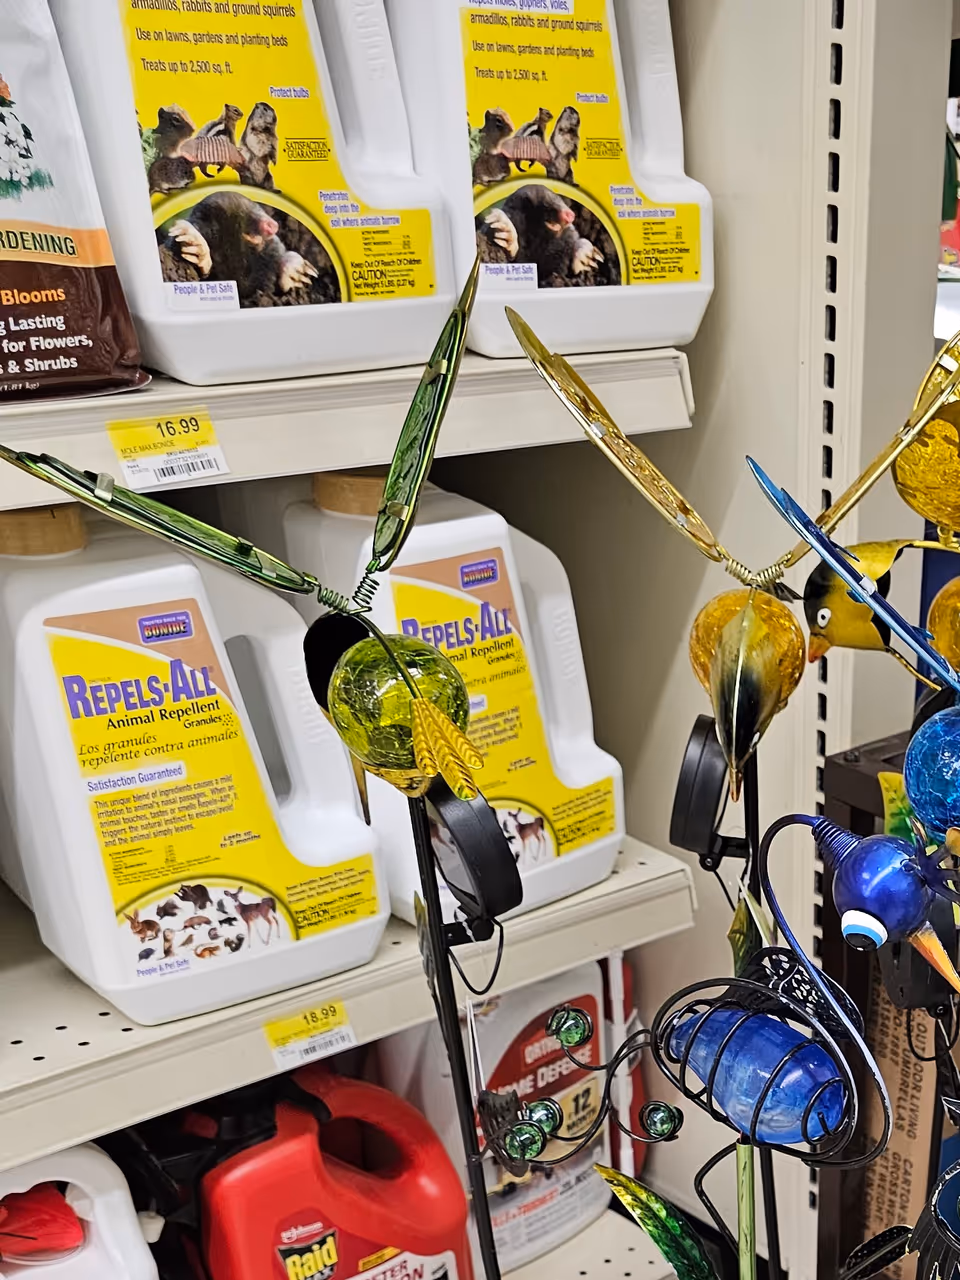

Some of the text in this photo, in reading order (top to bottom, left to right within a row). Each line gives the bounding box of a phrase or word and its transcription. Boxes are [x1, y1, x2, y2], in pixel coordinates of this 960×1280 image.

[182, 0, 212, 13] rabbits
[215, 0, 230, 14] and
[232, 2, 260, 17] ground
[262, 3, 295, 19] squirrels
[136, 27, 288, 48] Use on lawns, gardens and planting beds
[141, 57, 167, 72] Treats
[168, 60, 179, 74] up
[180, 60, 188, 73] to
[190, 60, 211, 75] 2,500
[352, 268, 387, 281] CAUTION
[0, 288, 66, 306] Blooms
[173, 283, 199, 295] People
[206, 283, 219, 294] Pet
[219, 282, 234, 294] Safe
[8, 314, 66, 331] Lasting
[2, 333, 94, 353] for Flowers,
[7, 359, 20, 374] &
[24, 355, 79, 373] Shrubs
[156, 416, 200, 438] 16.99
[143, 621, 188, 639] BONIDE
[470, 637, 515, 659] Repellent
[106, 699, 221, 730] Animal Repellent
[183, 712, 223, 729] Granules
[78, 732, 158, 756] Los granules
[81, 729, 239, 770] repelente contra animales
[87, 765, 183, 793] Satisfaction Guaranteed
[303, 1004, 337, 1026] 18.99
[571, 1087, 592, 1115] 12
